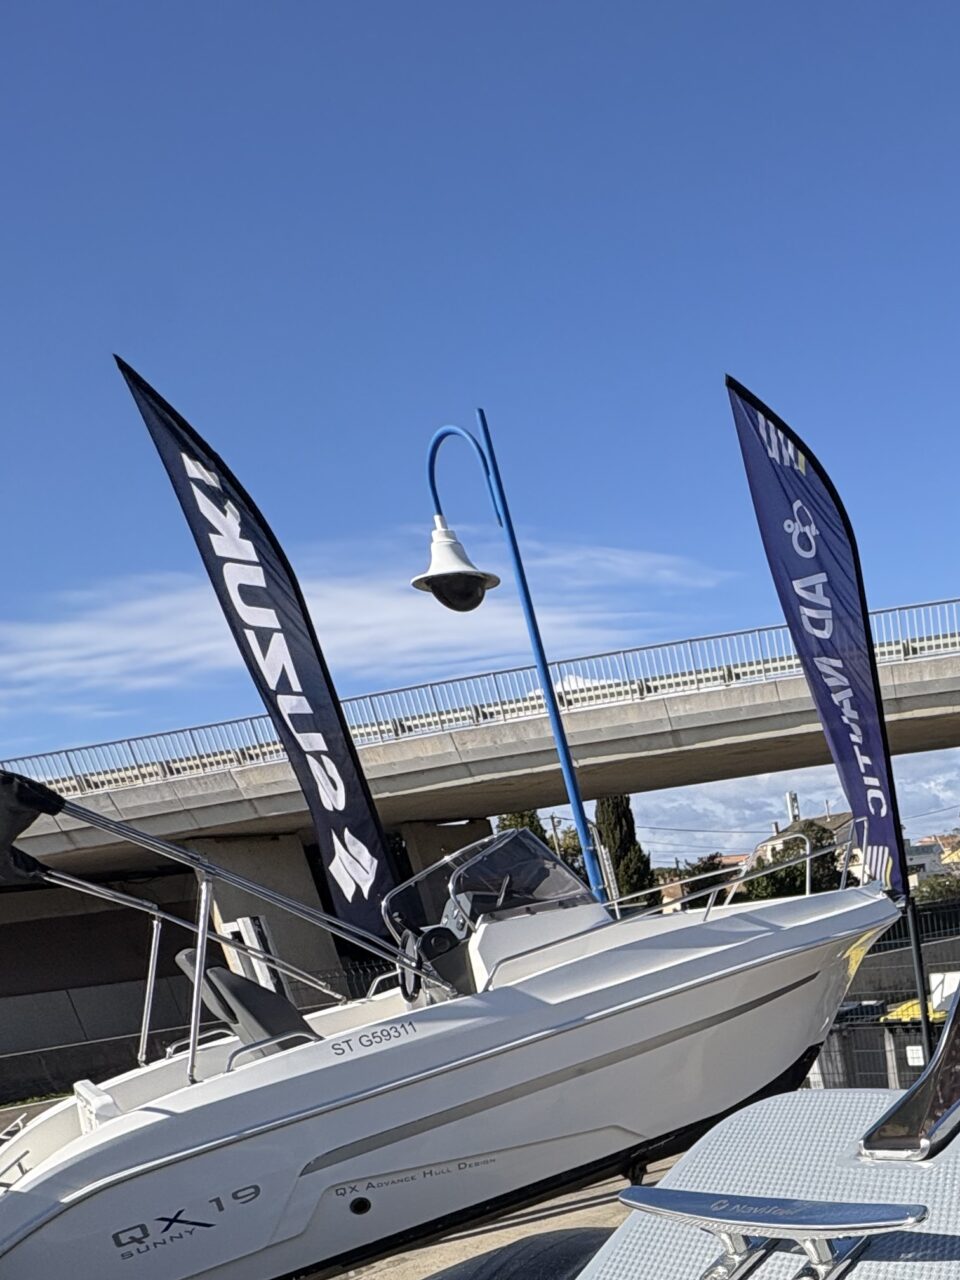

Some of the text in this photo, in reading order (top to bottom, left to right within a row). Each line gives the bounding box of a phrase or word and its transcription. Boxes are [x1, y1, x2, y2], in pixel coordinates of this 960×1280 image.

[331, 1019, 417, 1055] ST G59311
[335, 1184, 360, 1197] QX
[112, 1184, 261, 1248] QX 19
[121, 1228, 196, 1259] SUNNY
